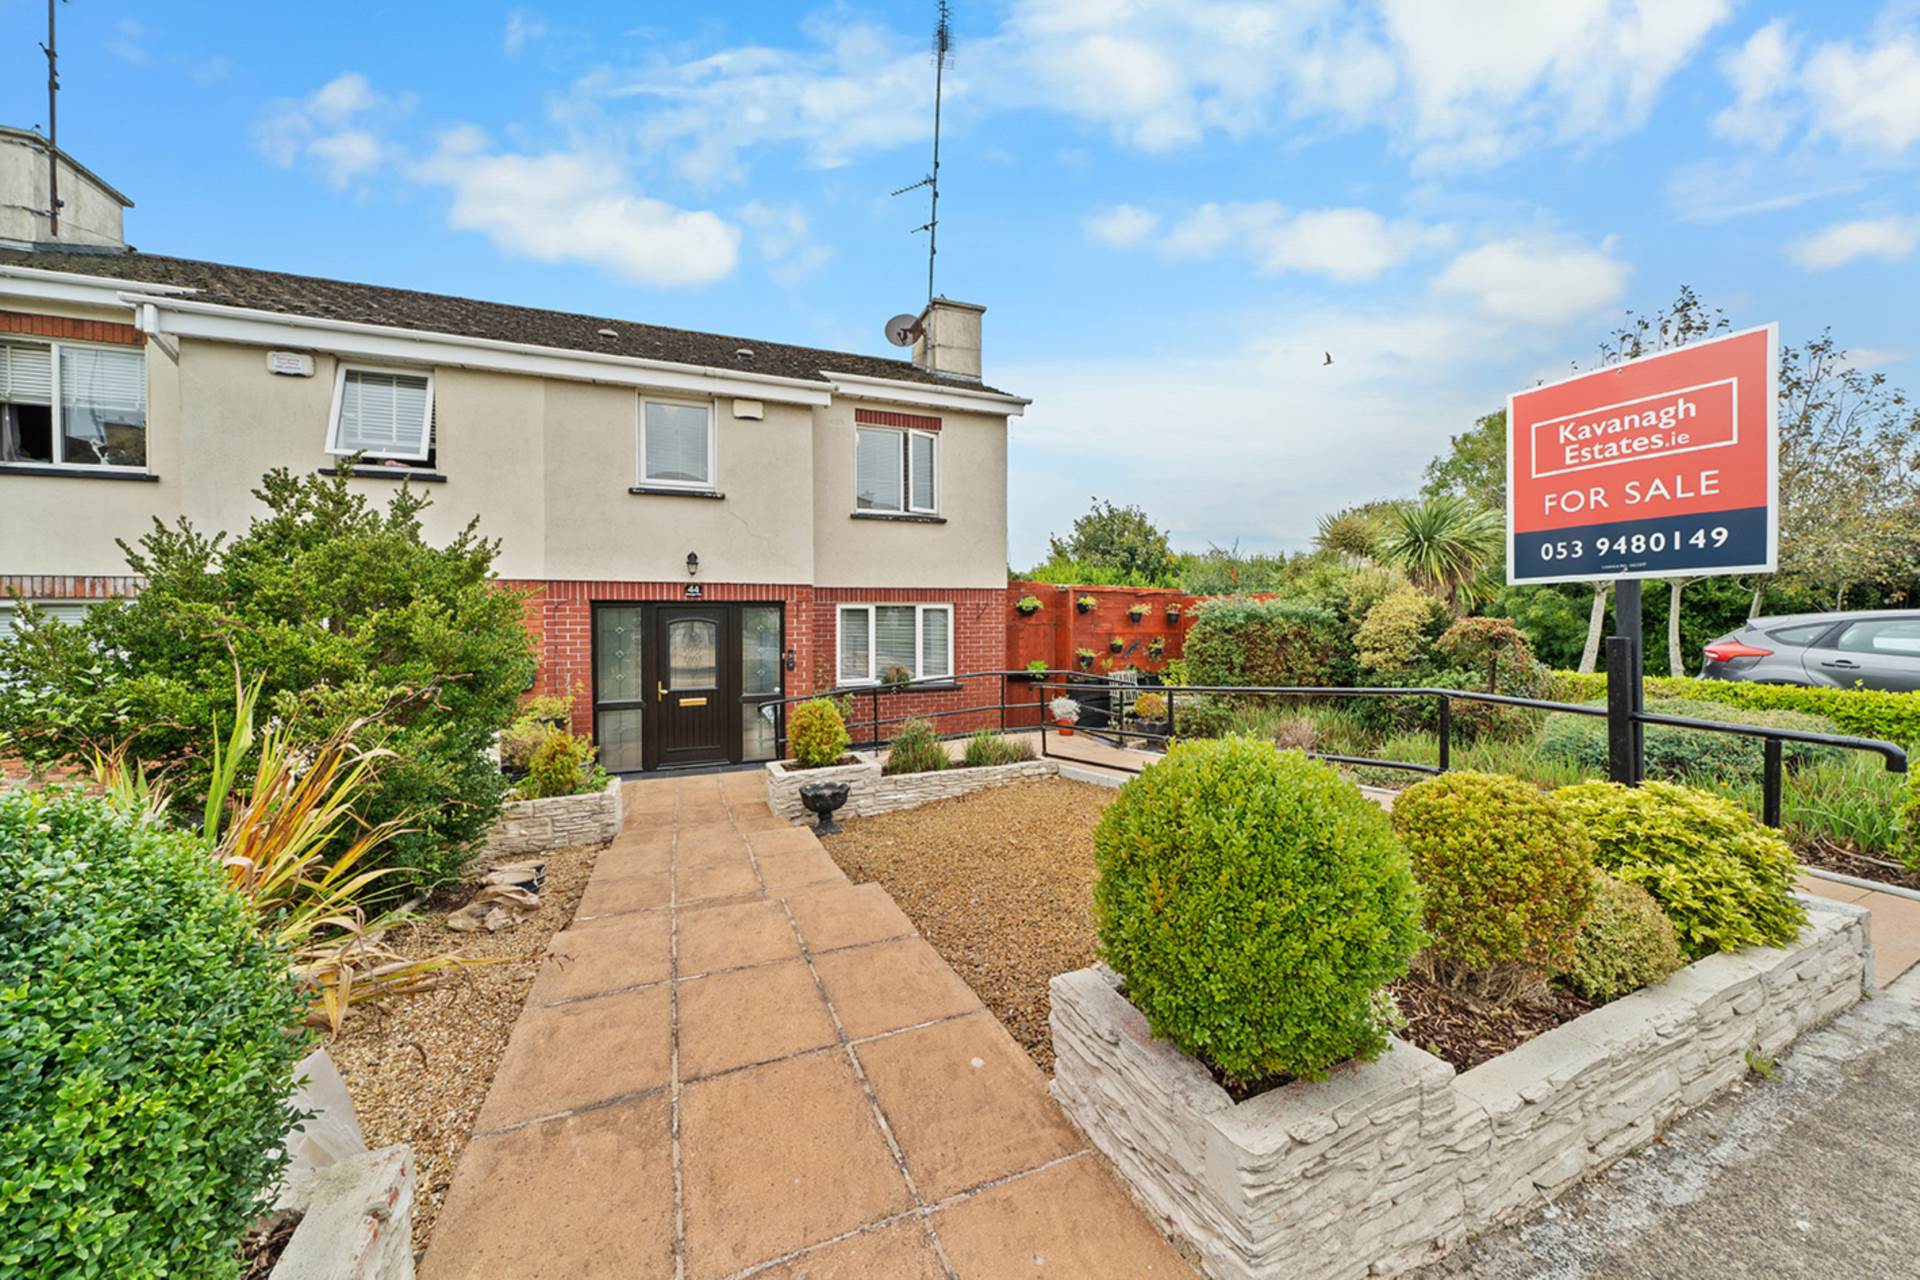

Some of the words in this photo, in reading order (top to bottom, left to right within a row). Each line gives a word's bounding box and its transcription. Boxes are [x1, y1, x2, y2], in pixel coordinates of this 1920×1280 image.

[1559, 398, 1697, 444] Kavanagh
[1565, 431, 1690, 465] Estates.ie
[1544, 487, 1609, 515] FOR
[1624, 469, 1720, 504] SALE
[1540, 540, 1584, 561] 053
[1596, 526, 1729, 556] 9480149
[687, 585, 700, 593] 44
